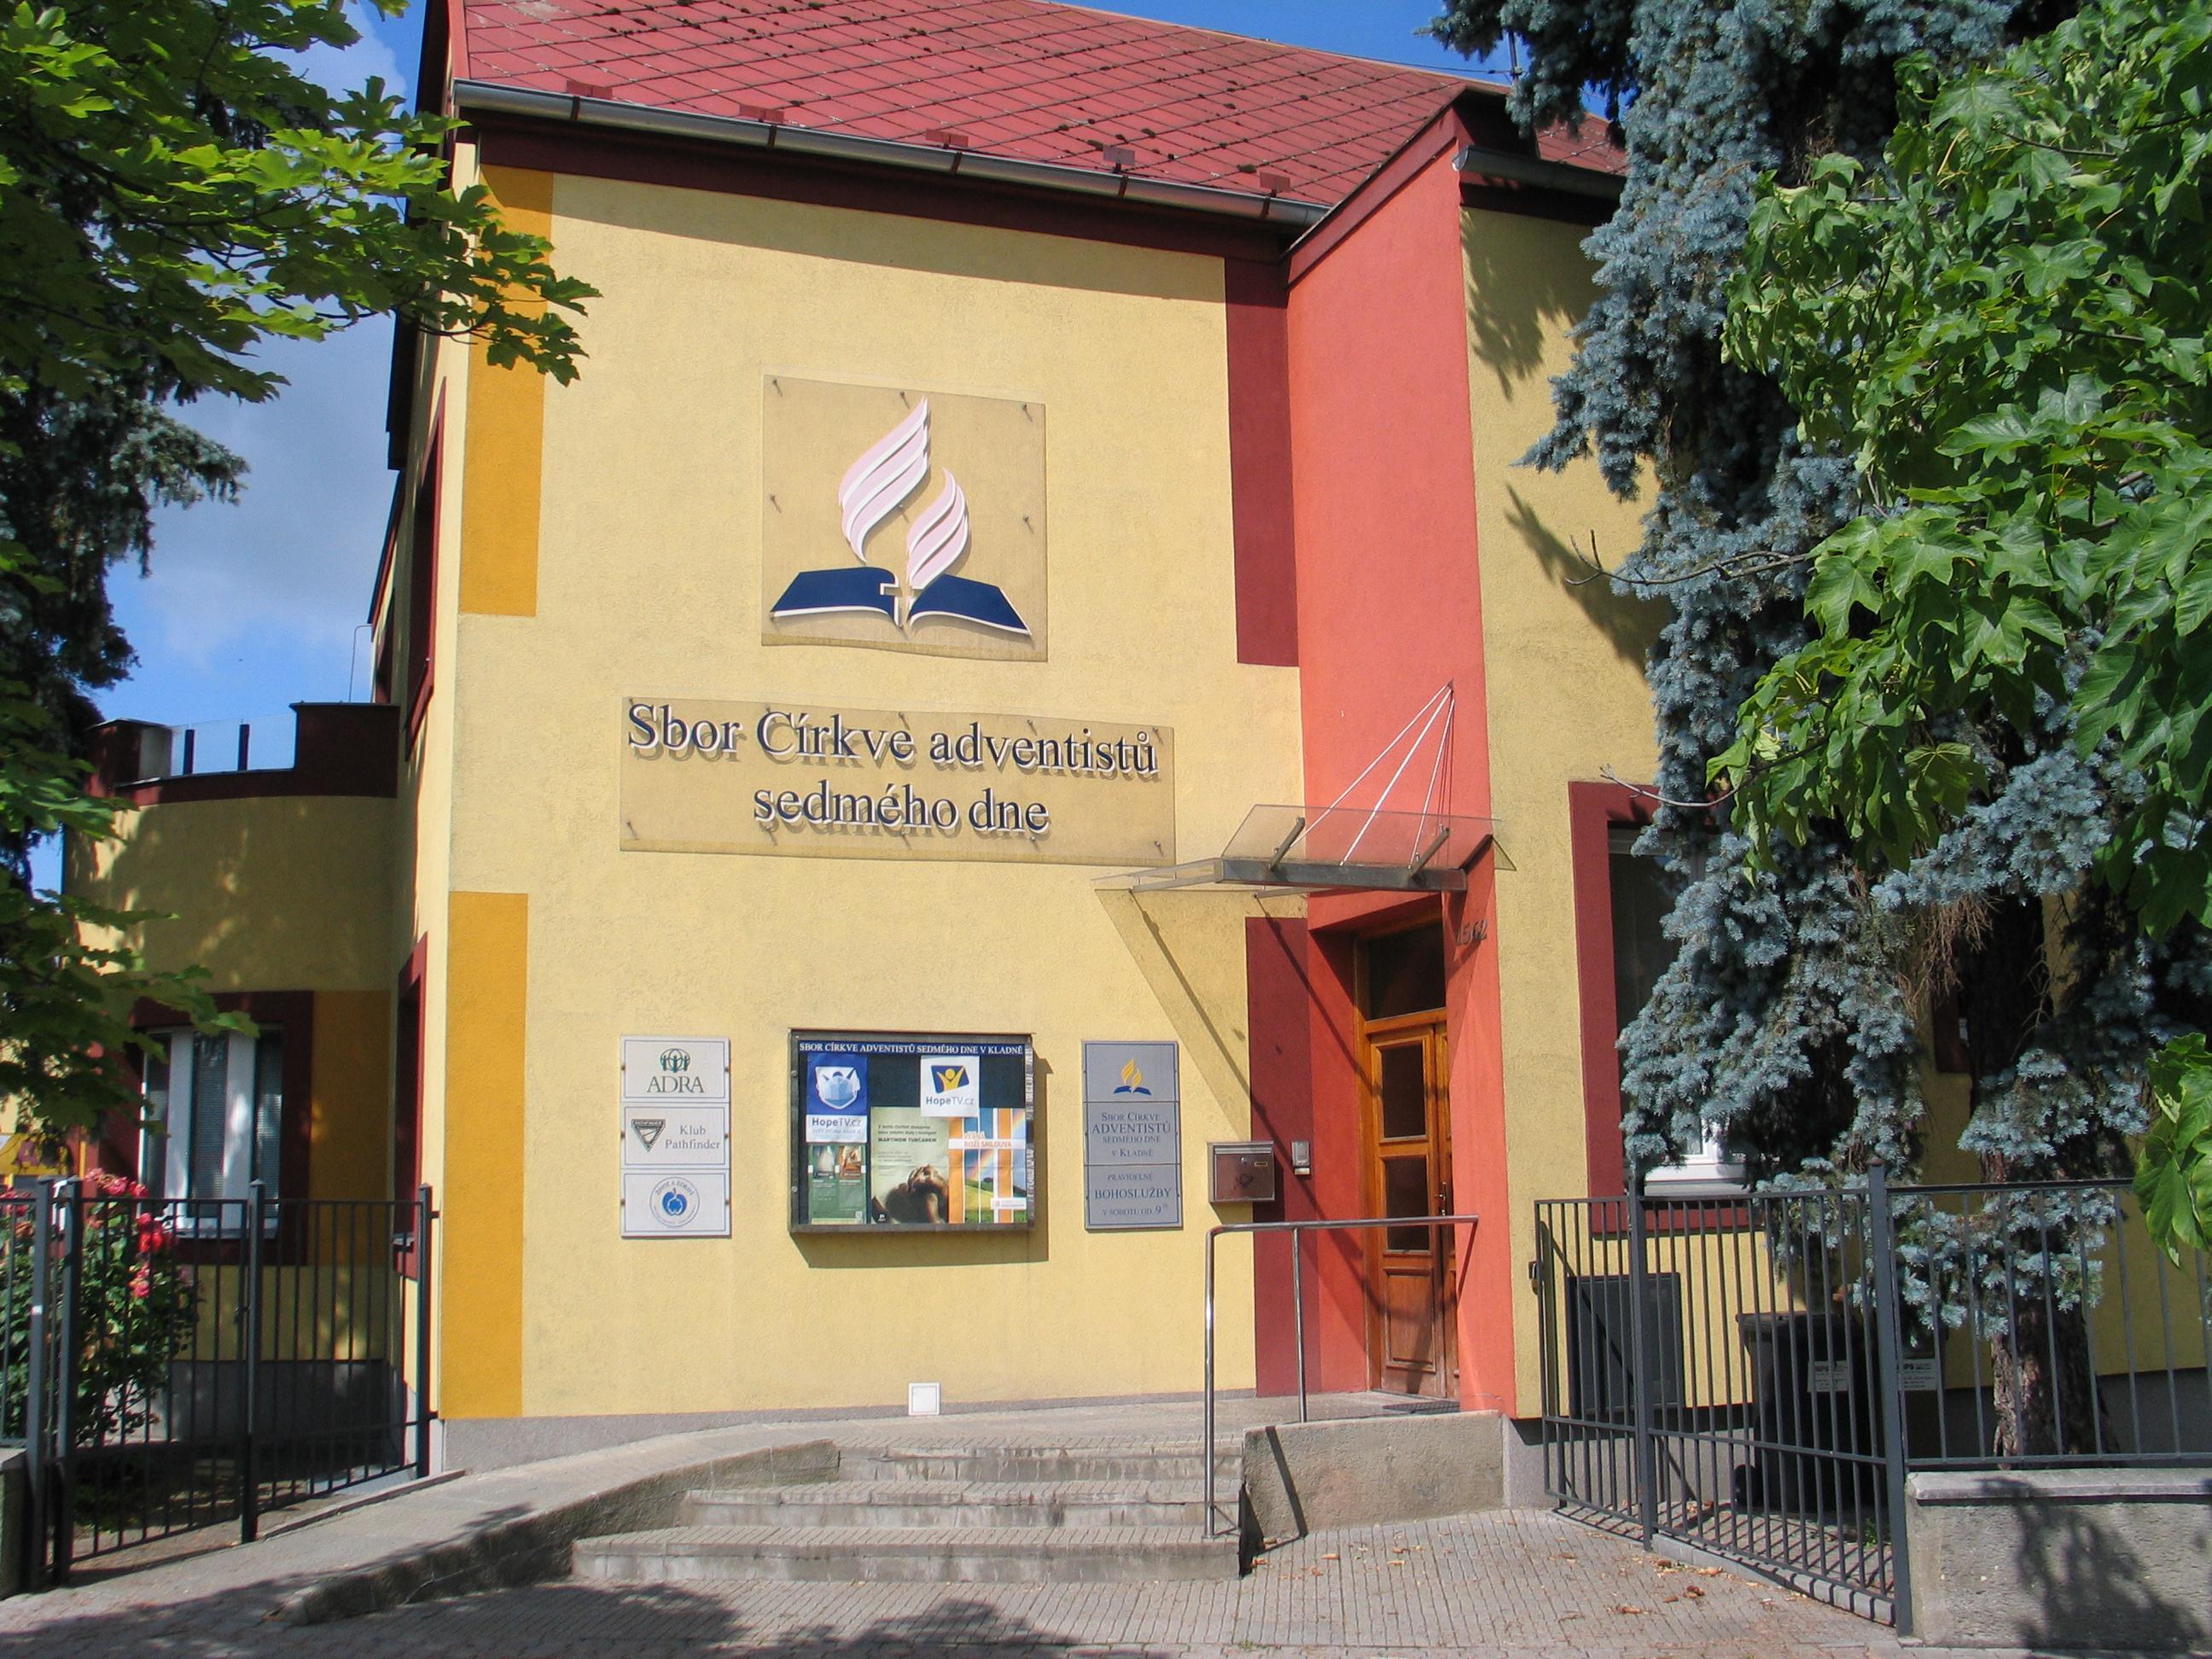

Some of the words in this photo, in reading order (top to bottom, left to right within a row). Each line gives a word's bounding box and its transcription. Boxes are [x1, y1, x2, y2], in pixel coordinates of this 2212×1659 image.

[628, 704, 741, 754] Sbor
[757, 711, 917, 761] Církve
[929, 719, 1159, 775] adventistů
[754, 780, 958, 830] sedmého
[969, 788, 1051, 834] dne
[799, 1042, 824, 1051] SBOR
[824, 1041, 859, 1052] CÍRKVE
[859, 1043, 916, 1054] ADVENTISTŮ
[917, 1044, 959, 1054] SEDMÉHO
[960, 1045, 978, 1054] DNE
[979, 1045, 987, 1054] V
[646, 1075, 705, 1093] ADRA
[925, 1095, 975, 1106] HopeTV.cz
[812, 1117, 862, 1128] HopeTV.cz
[1092, 1120, 1172, 1134] ADVENTISTŮ
[679, 1125, 707, 1136] Klub
[665, 1139, 721, 1150] Pathfinder
[1095, 1185, 1172, 1199] BOHOSLUŽBY
